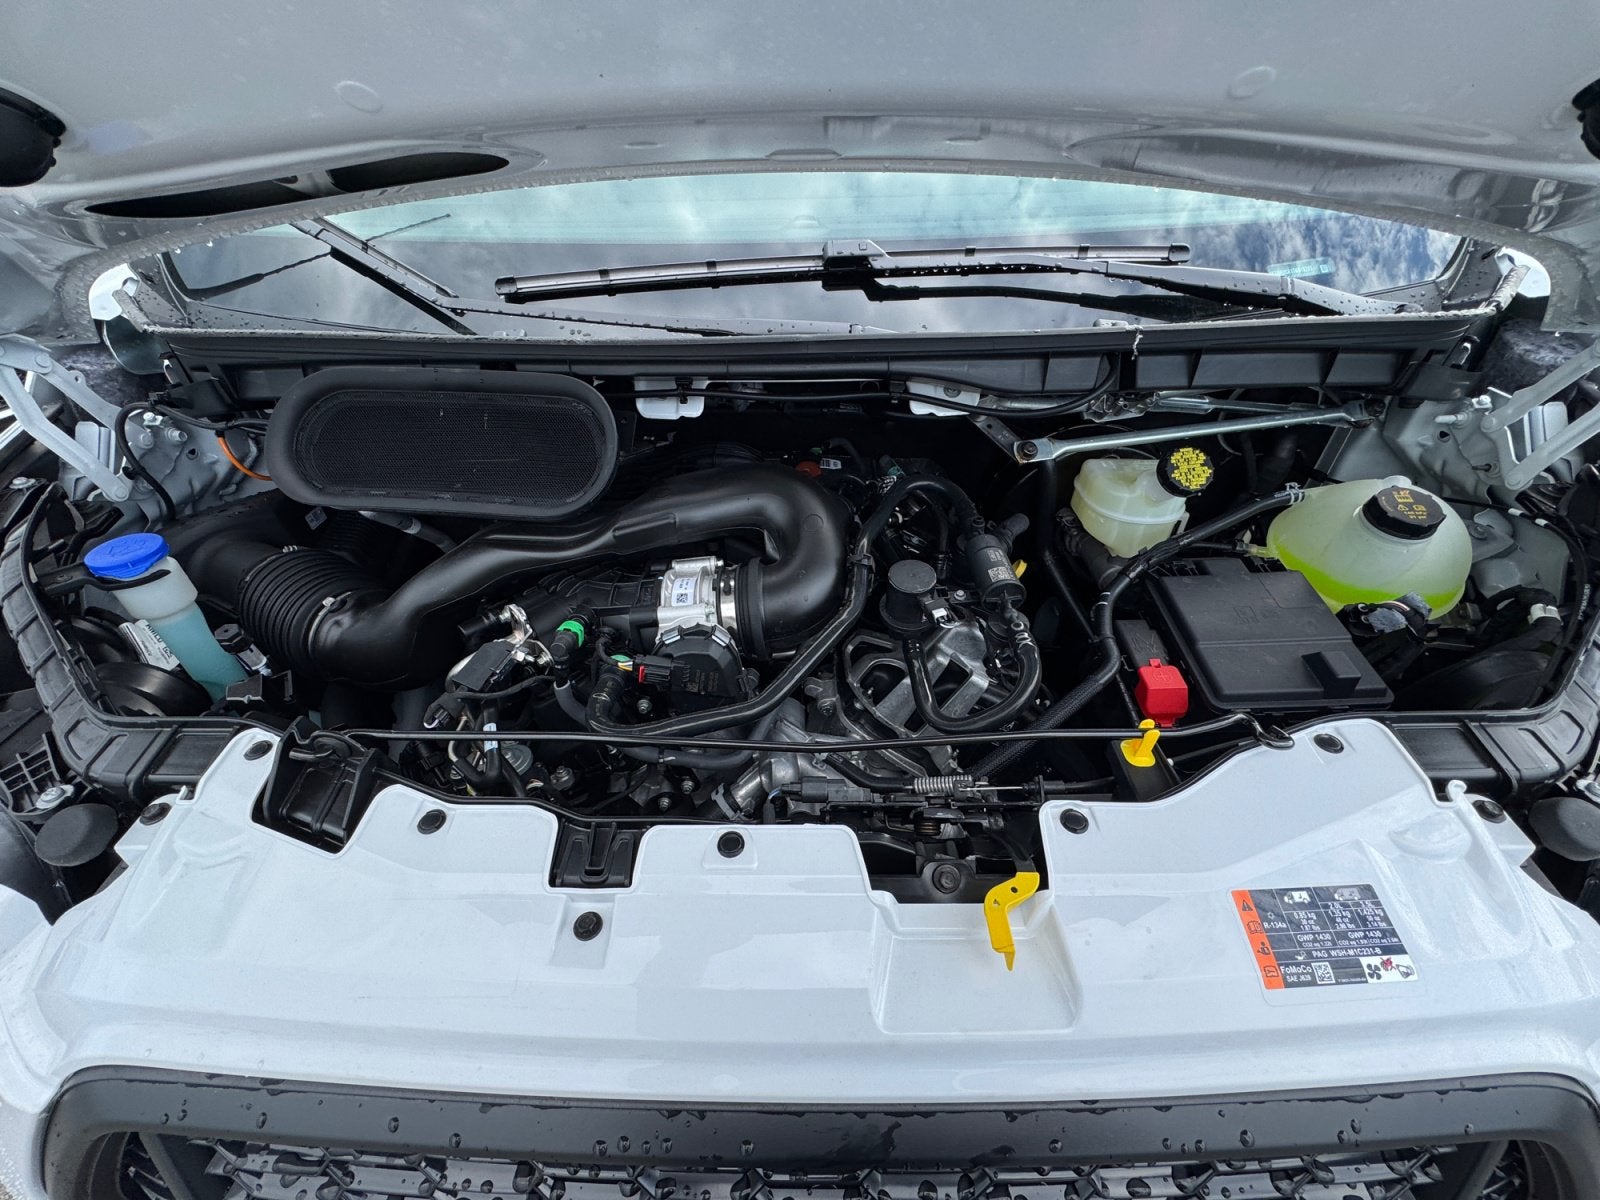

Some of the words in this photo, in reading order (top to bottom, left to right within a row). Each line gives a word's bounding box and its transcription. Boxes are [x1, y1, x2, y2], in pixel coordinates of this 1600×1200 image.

[1264, 921, 1287, 929] R-134a
[1312, 950, 1327, 958] PAG
[1330, 948, 1382, 957] WSH-M1C231-B
[1280, 965, 1312, 974] FoMoCo
